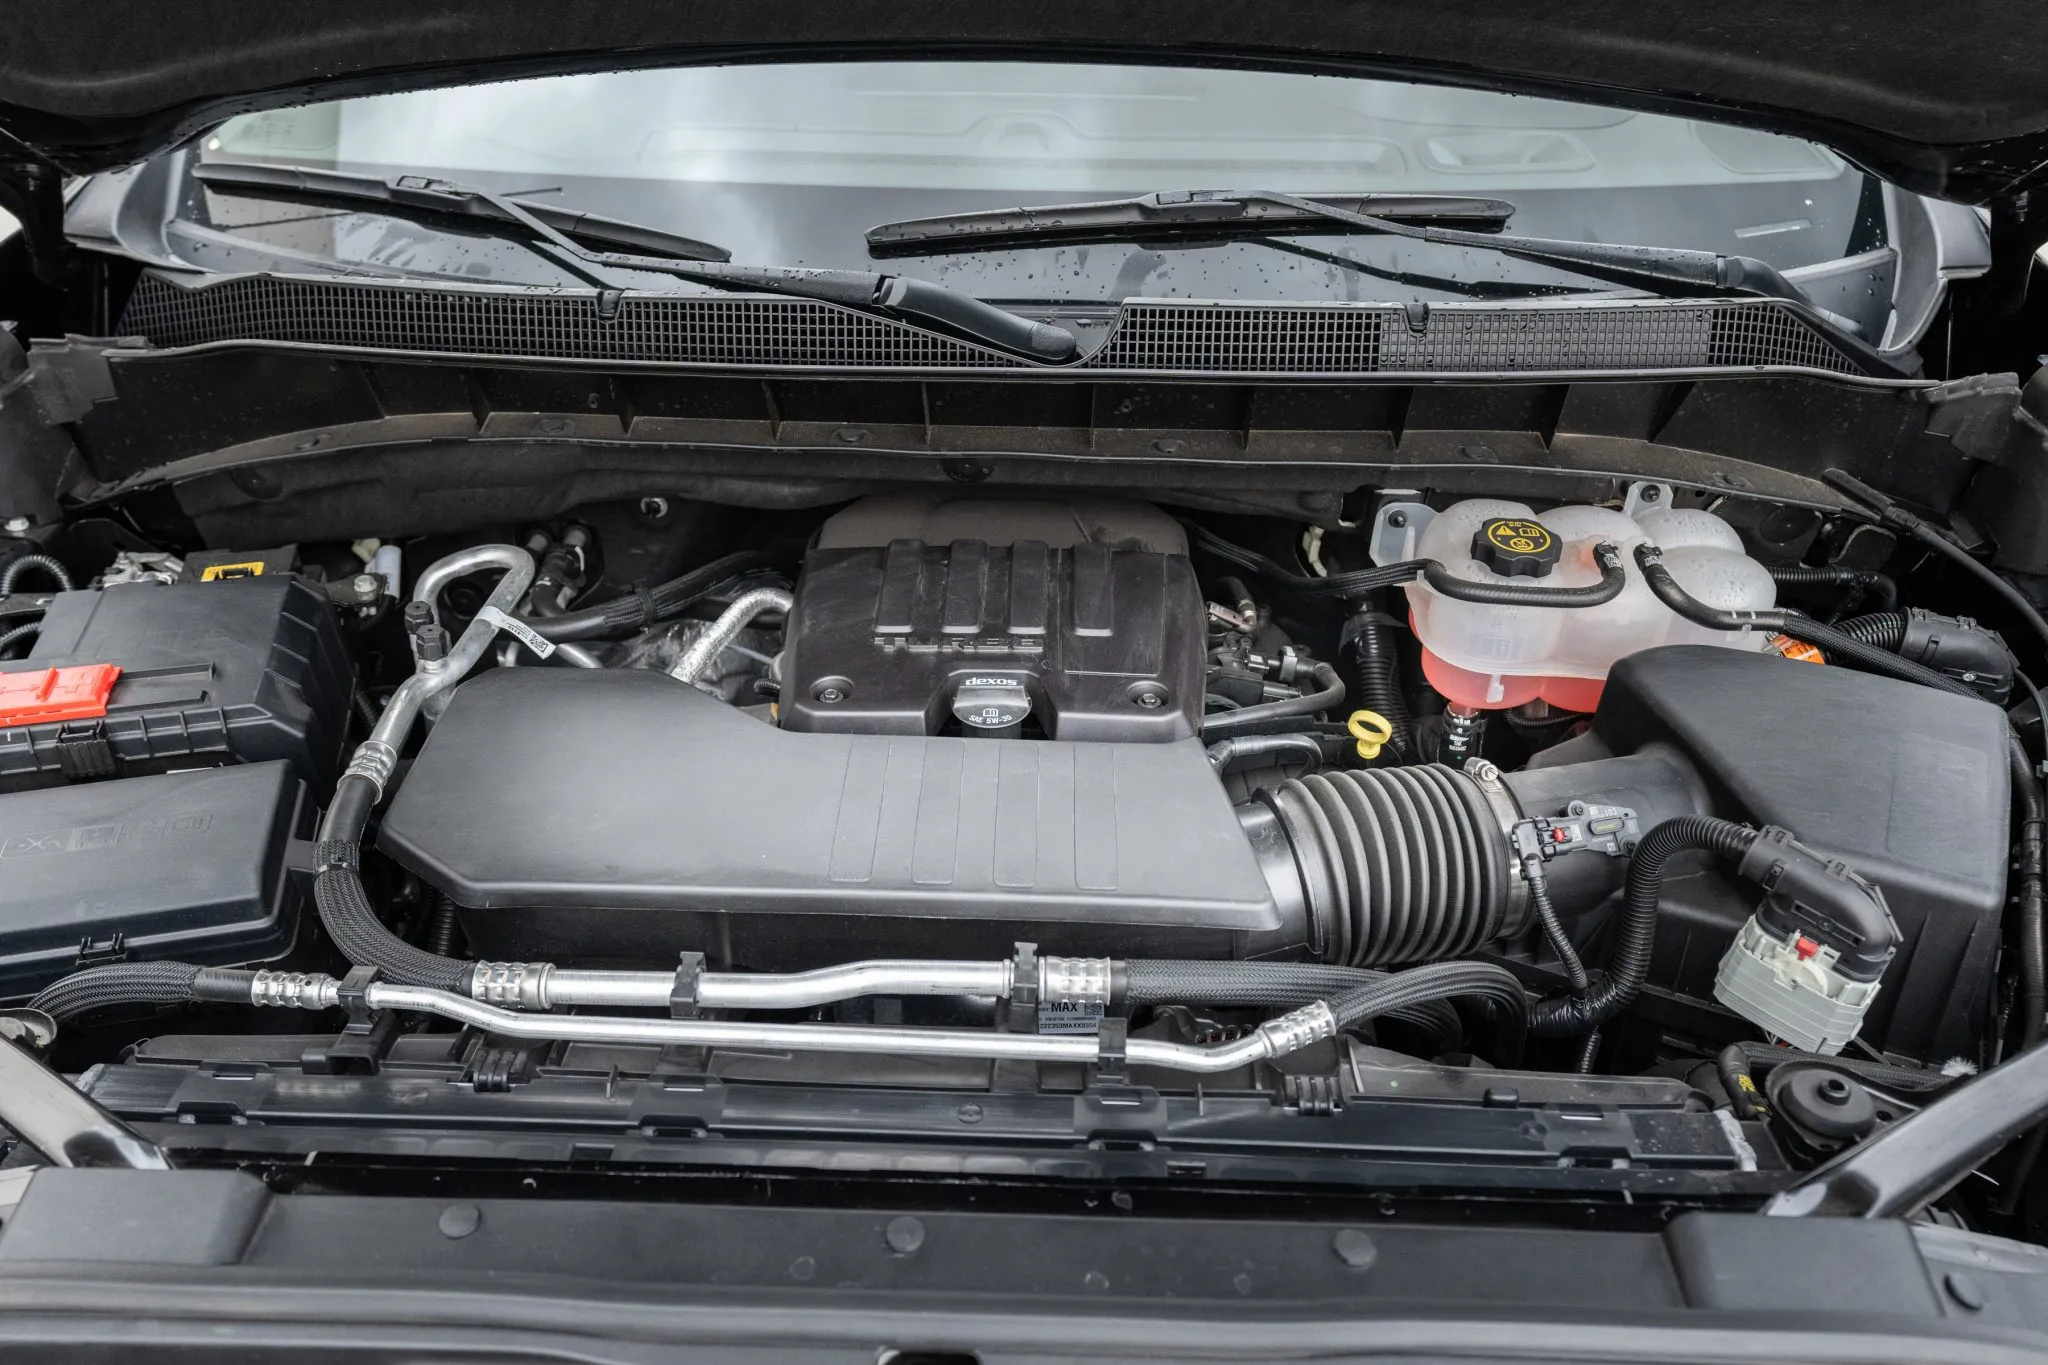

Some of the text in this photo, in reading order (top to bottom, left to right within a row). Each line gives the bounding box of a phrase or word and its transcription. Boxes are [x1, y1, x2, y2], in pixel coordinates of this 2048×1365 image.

[965, 677, 1017, 686] dexos
[969, 715, 1012, 724] SAE 5W-30
[1051, 1002, 1078, 1012] MAX
